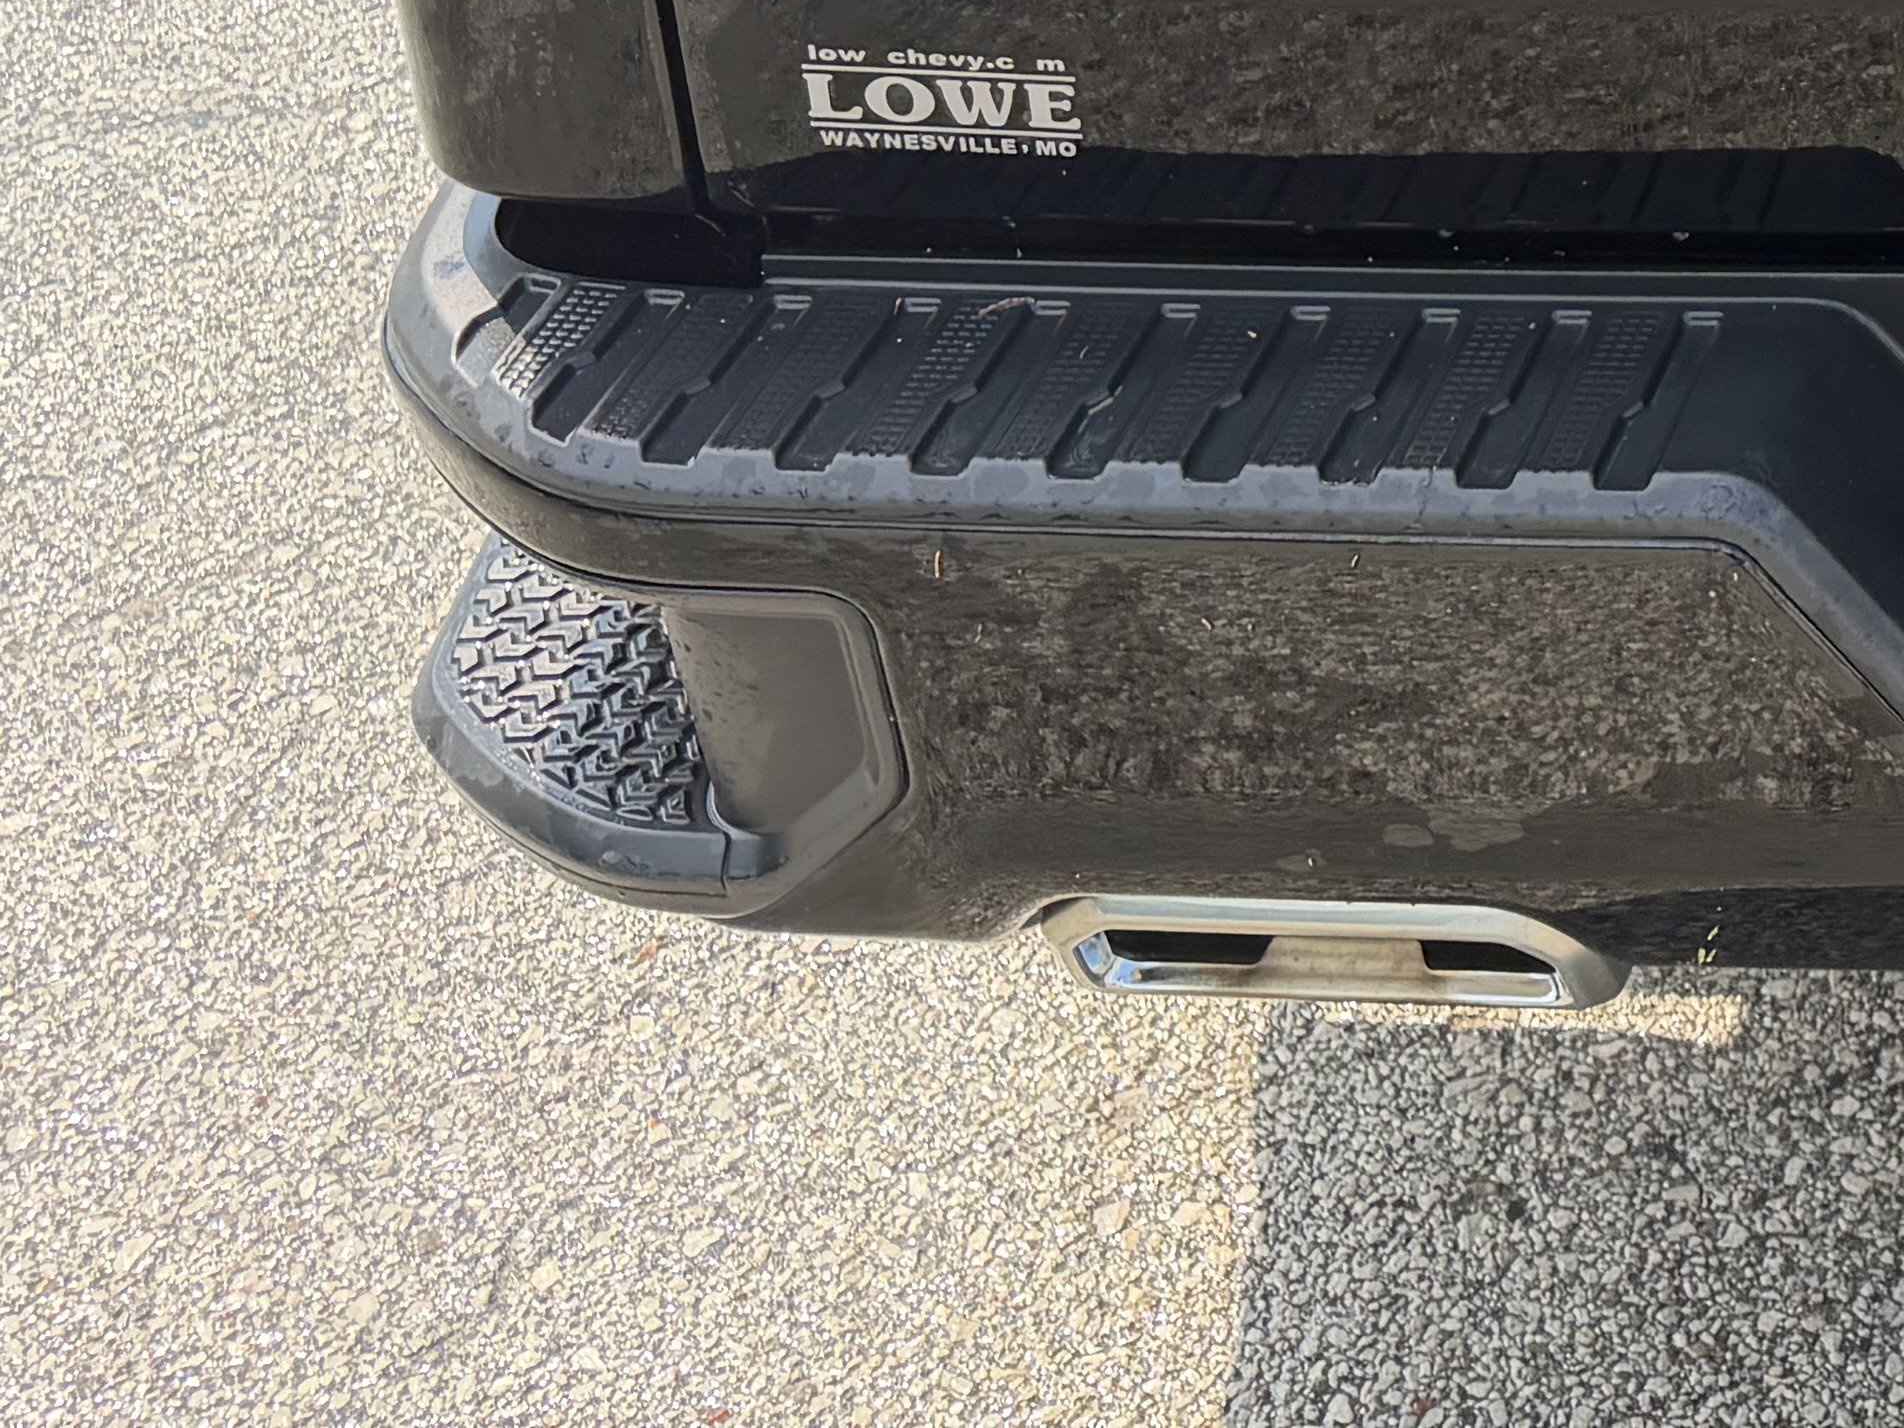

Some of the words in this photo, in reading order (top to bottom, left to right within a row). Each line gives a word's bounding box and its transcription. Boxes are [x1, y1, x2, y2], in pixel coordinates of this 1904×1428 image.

[801, 72, 1082, 131] LOWE
[819, 129, 1030, 156] WAYNESVILLE,
[1034, 140, 1077, 158] MO
